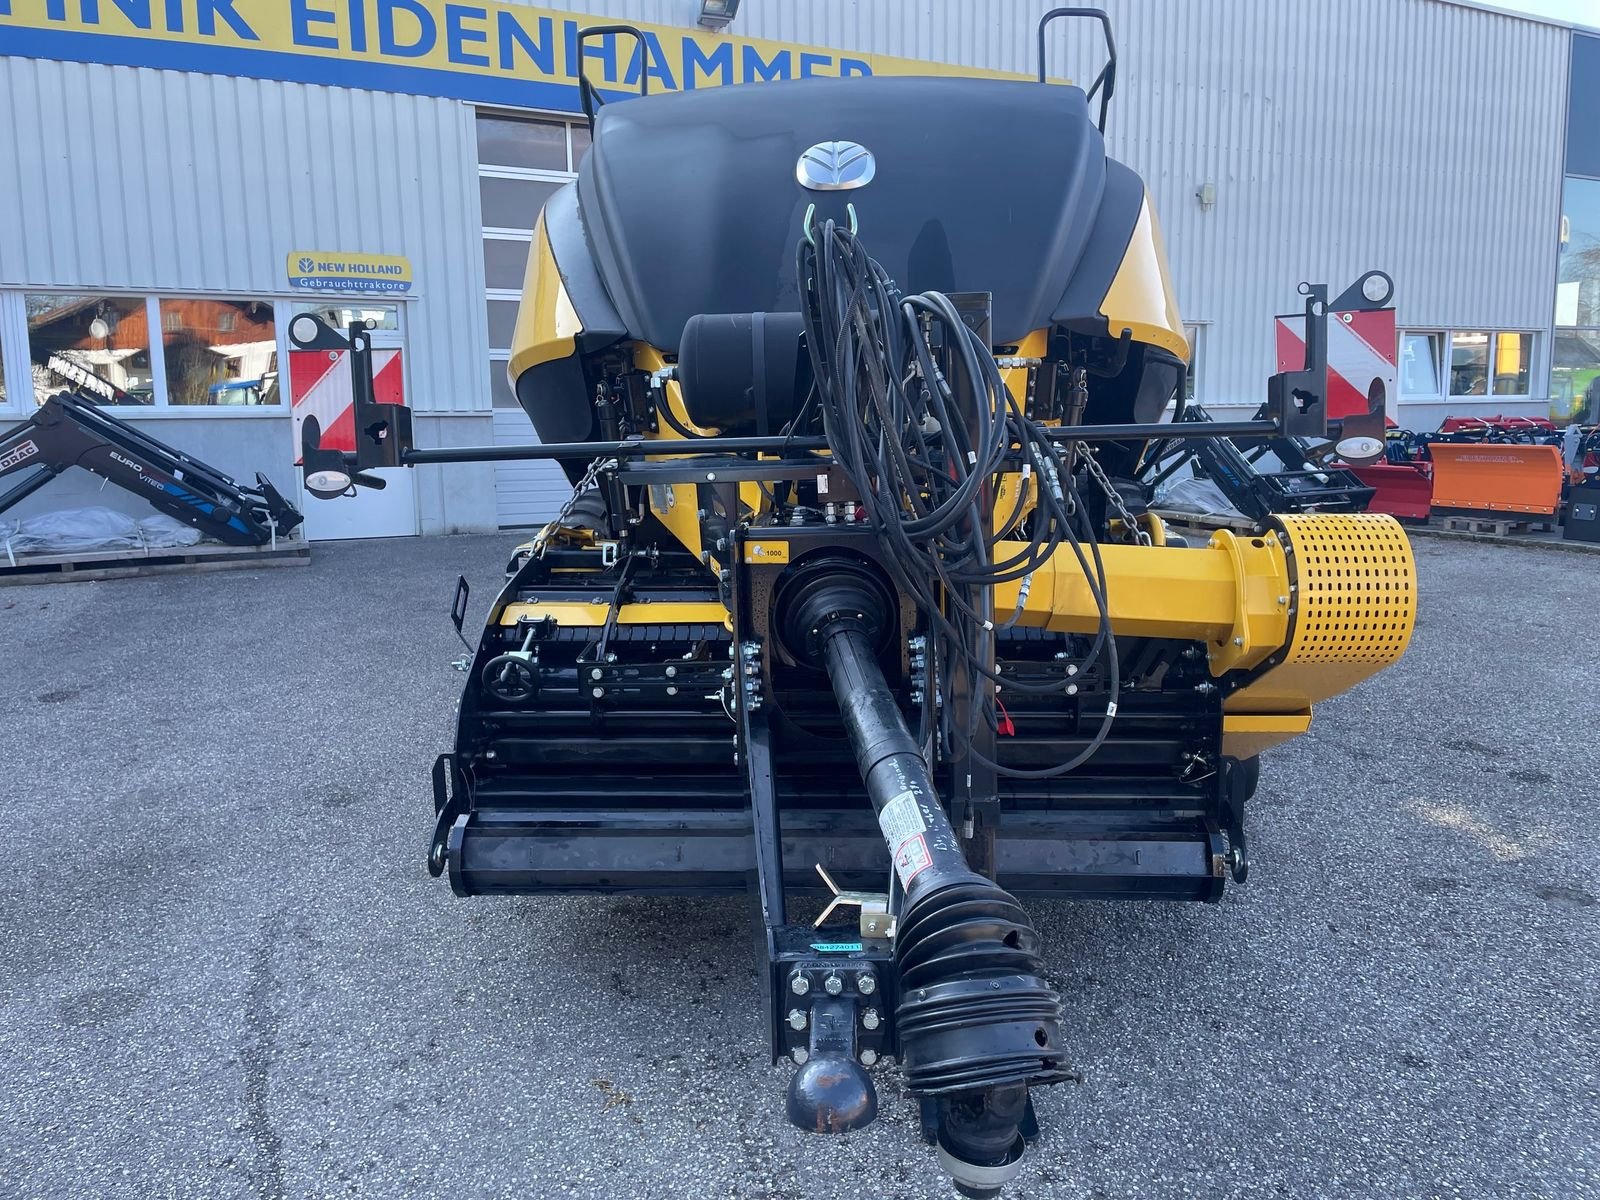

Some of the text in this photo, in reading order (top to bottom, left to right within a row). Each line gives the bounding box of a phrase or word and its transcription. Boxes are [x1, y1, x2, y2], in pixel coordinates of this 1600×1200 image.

[318, 262, 403, 275] NEW HOLLAND
[300, 278, 405, 290] Gebrauchttraktore
[110, 451, 143, 472] EURO
